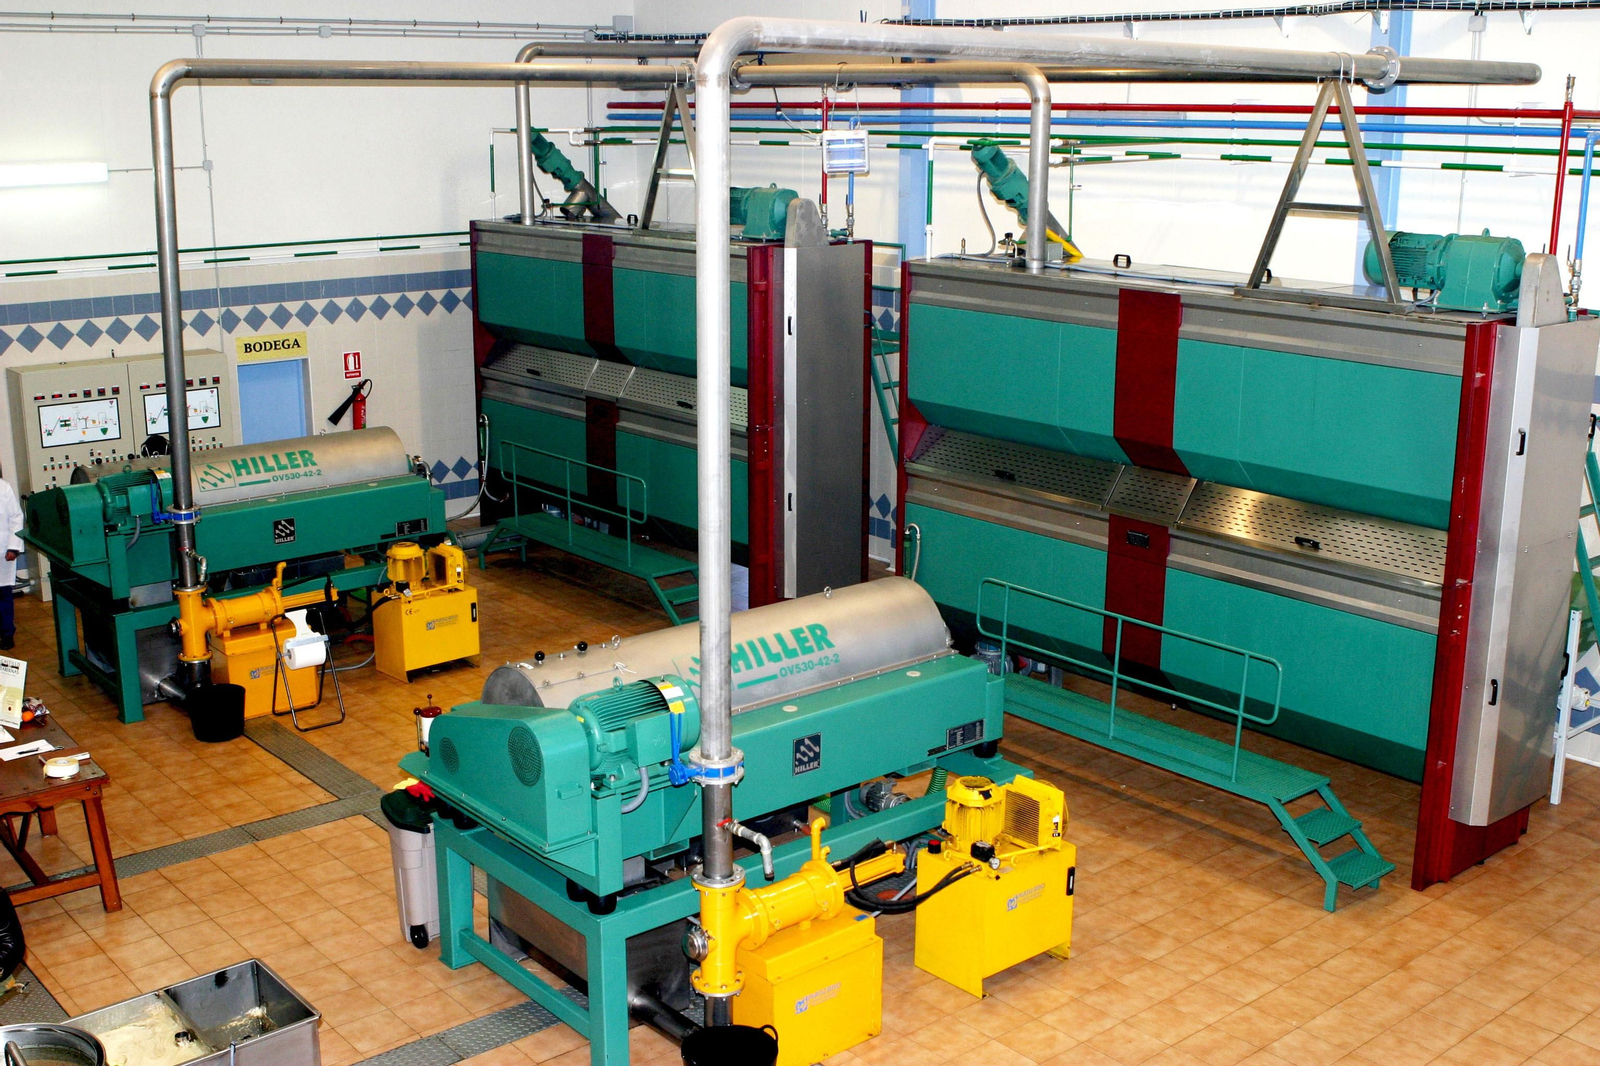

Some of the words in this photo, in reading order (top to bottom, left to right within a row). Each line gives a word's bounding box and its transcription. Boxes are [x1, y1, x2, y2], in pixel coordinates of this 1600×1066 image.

[244, 338, 301, 353] BODEGA
[231, 450, 318, 477] HILLER
[272, 469, 322, 482] OV530-42-2
[731, 623, 835, 674] HILLER
[779, 653, 841, 678] OV530-42-2
[795, 761, 819, 774] HILLER
